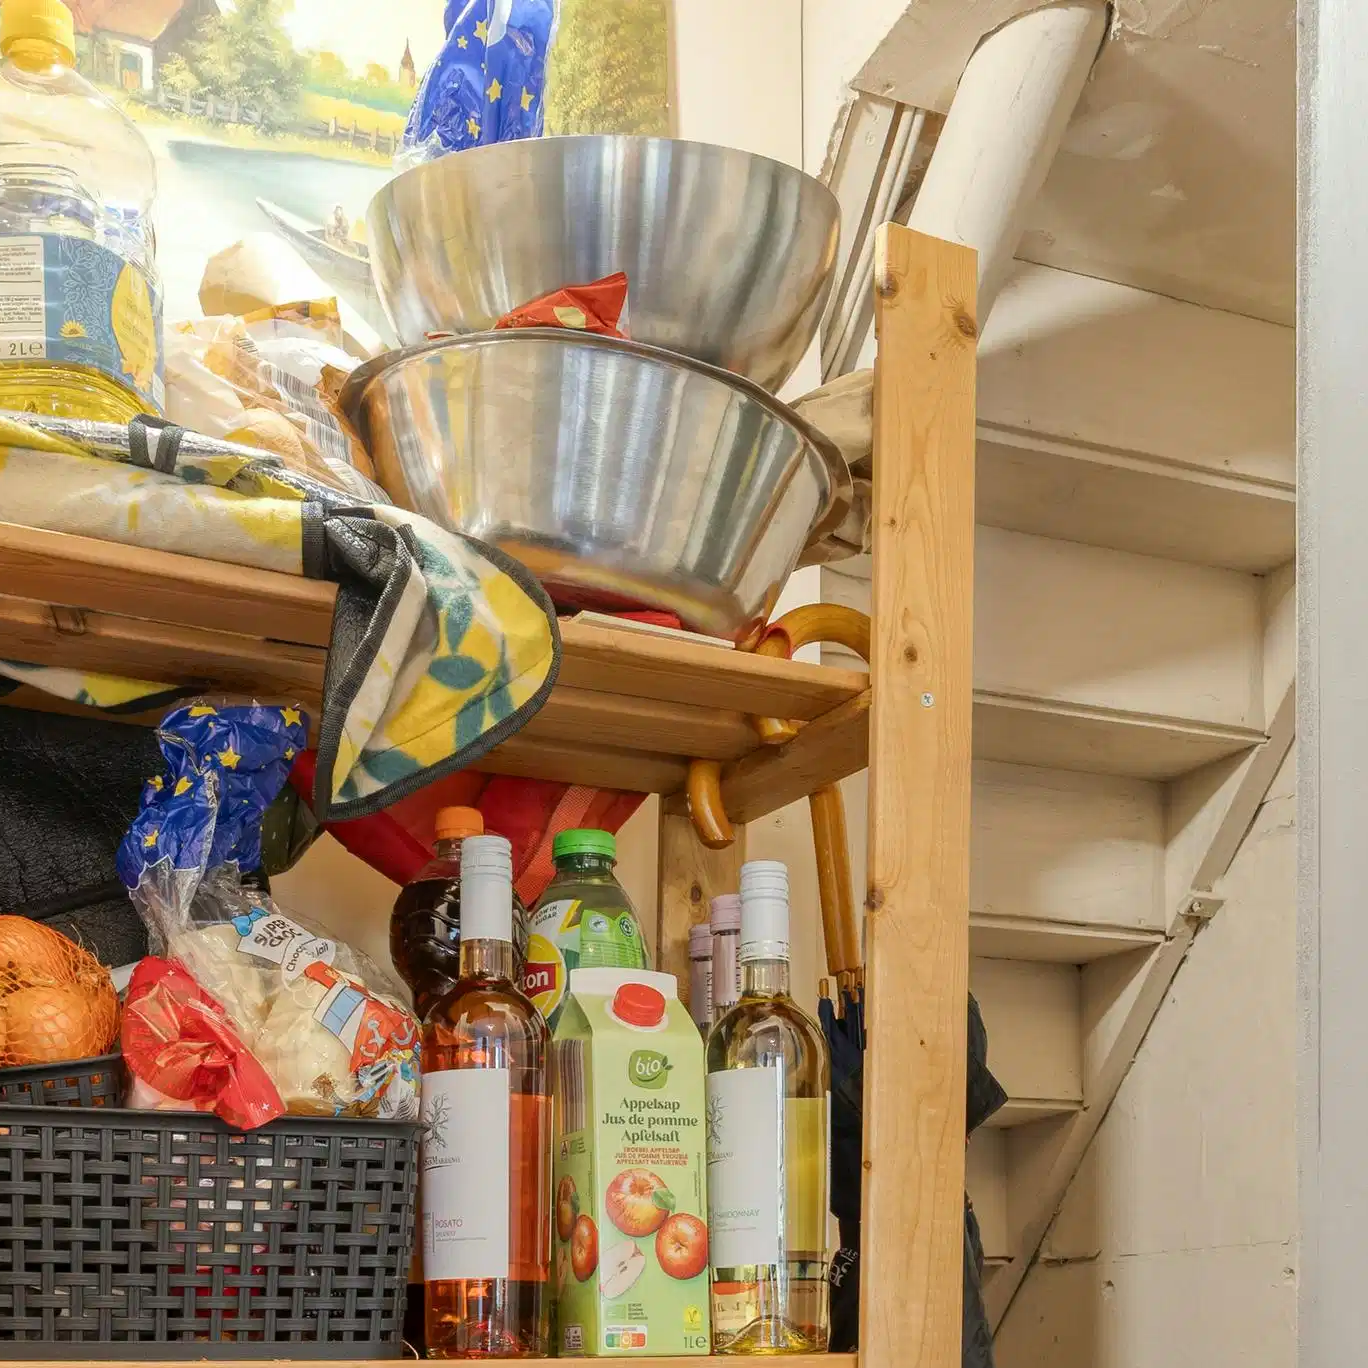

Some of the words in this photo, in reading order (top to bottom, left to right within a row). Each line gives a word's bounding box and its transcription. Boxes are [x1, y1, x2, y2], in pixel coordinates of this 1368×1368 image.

[635, 1056, 661, 1077] bio
[619, 1097, 680, 1113] Appelsap
[602, 1113, 626, 1125] Jus
[628, 1114, 644, 1125] de
[648, 1115, 698, 1129] pomme
[621, 1129, 680, 1144] Apfelsaft
